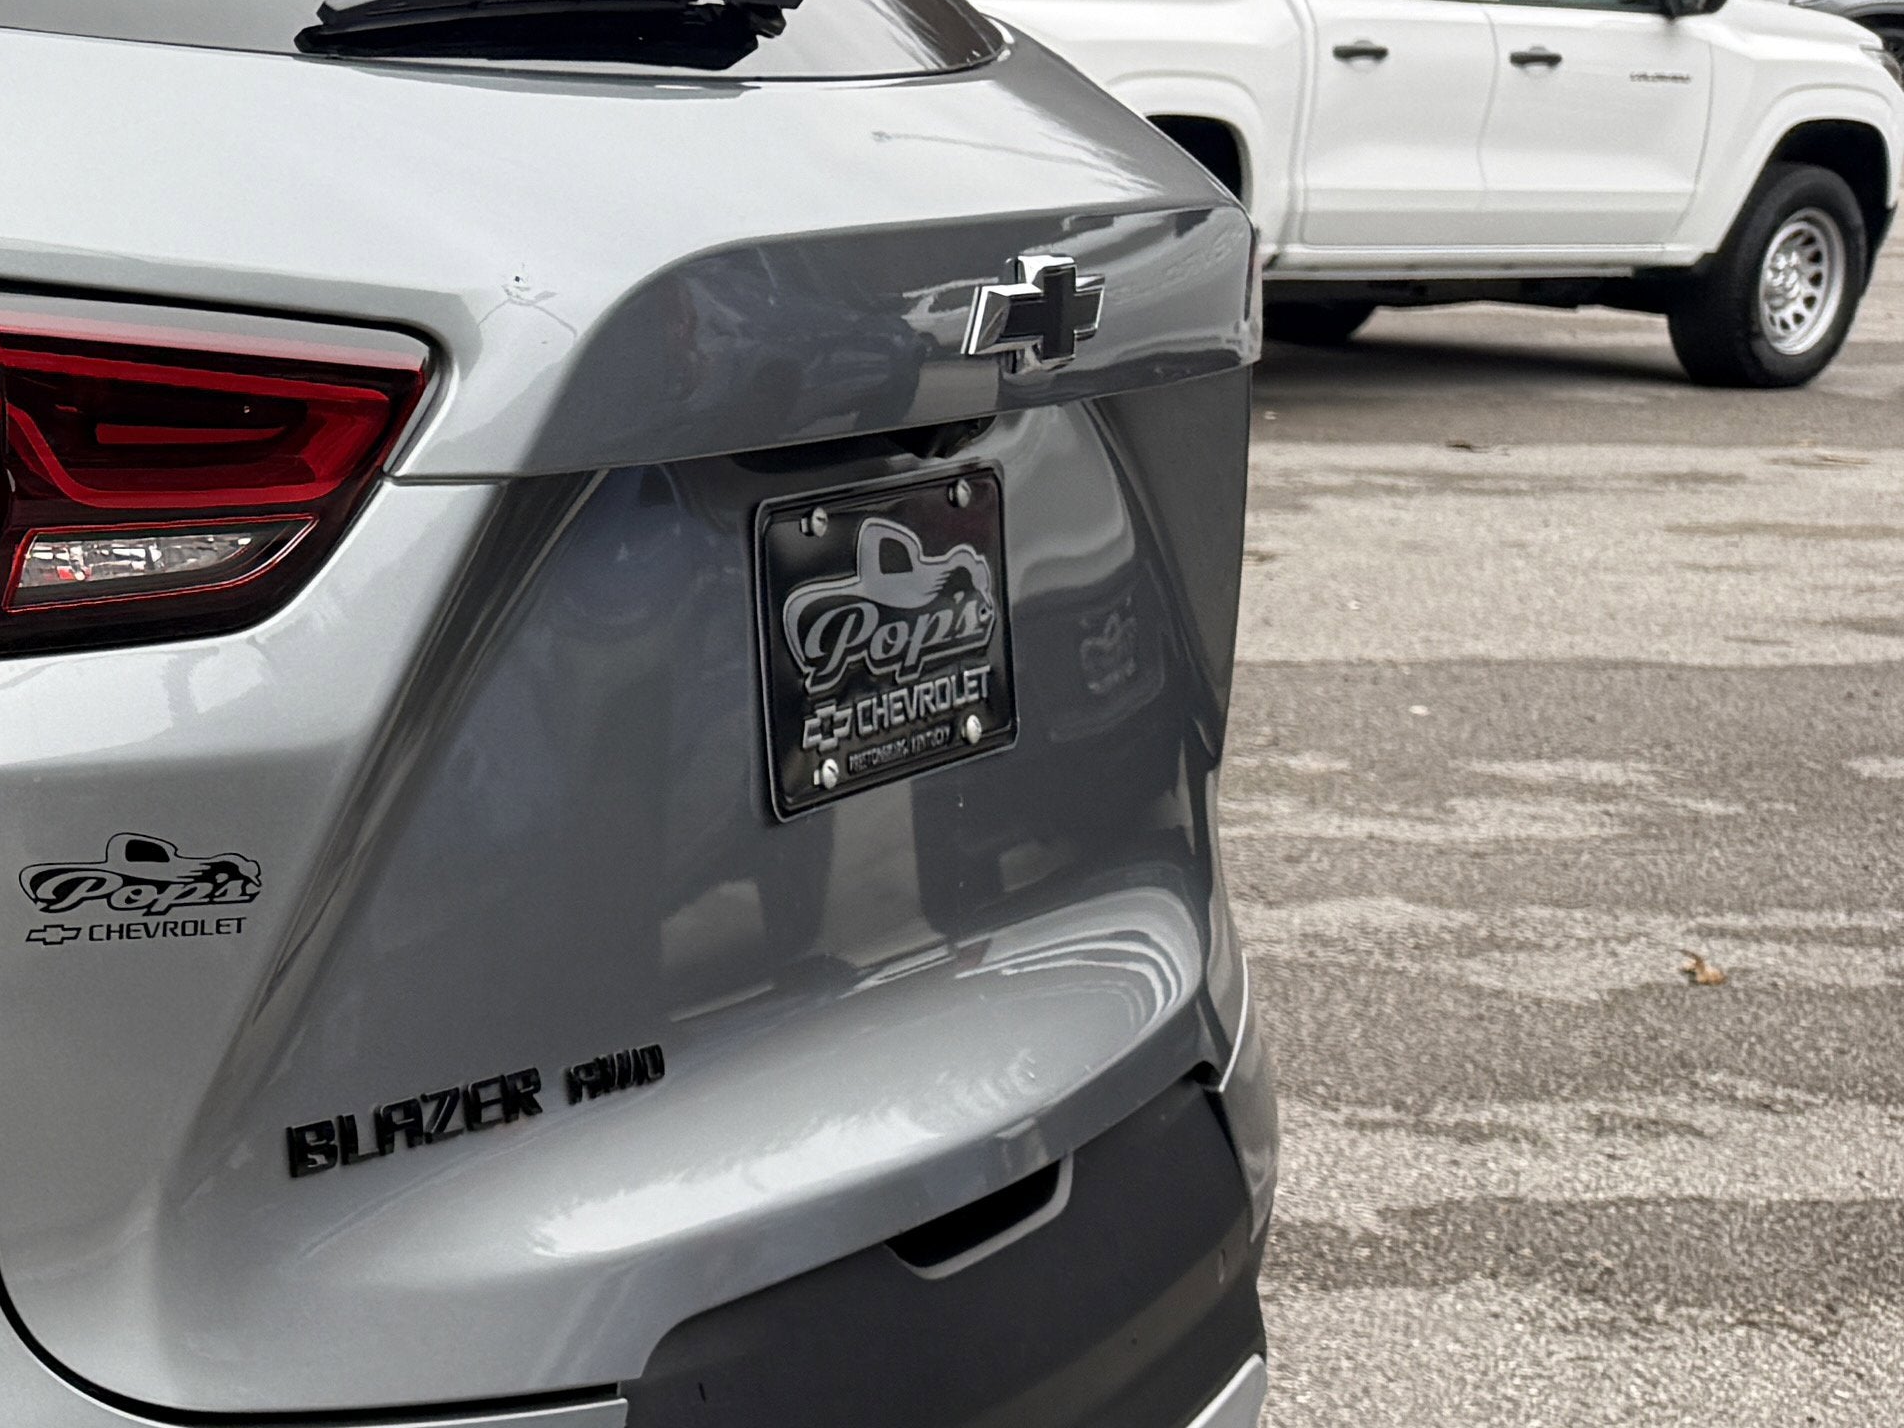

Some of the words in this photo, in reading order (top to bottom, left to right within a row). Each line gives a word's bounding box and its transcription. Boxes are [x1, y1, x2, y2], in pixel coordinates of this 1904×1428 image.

[803, 590, 985, 676] Pop's
[856, 664, 992, 737] CHEVROLET
[35, 870, 252, 913] Pop's
[88, 917, 247, 942] CHEVROLET
[285, 1067, 544, 1178] BLAZER
[564, 1043, 666, 1106] AWD
